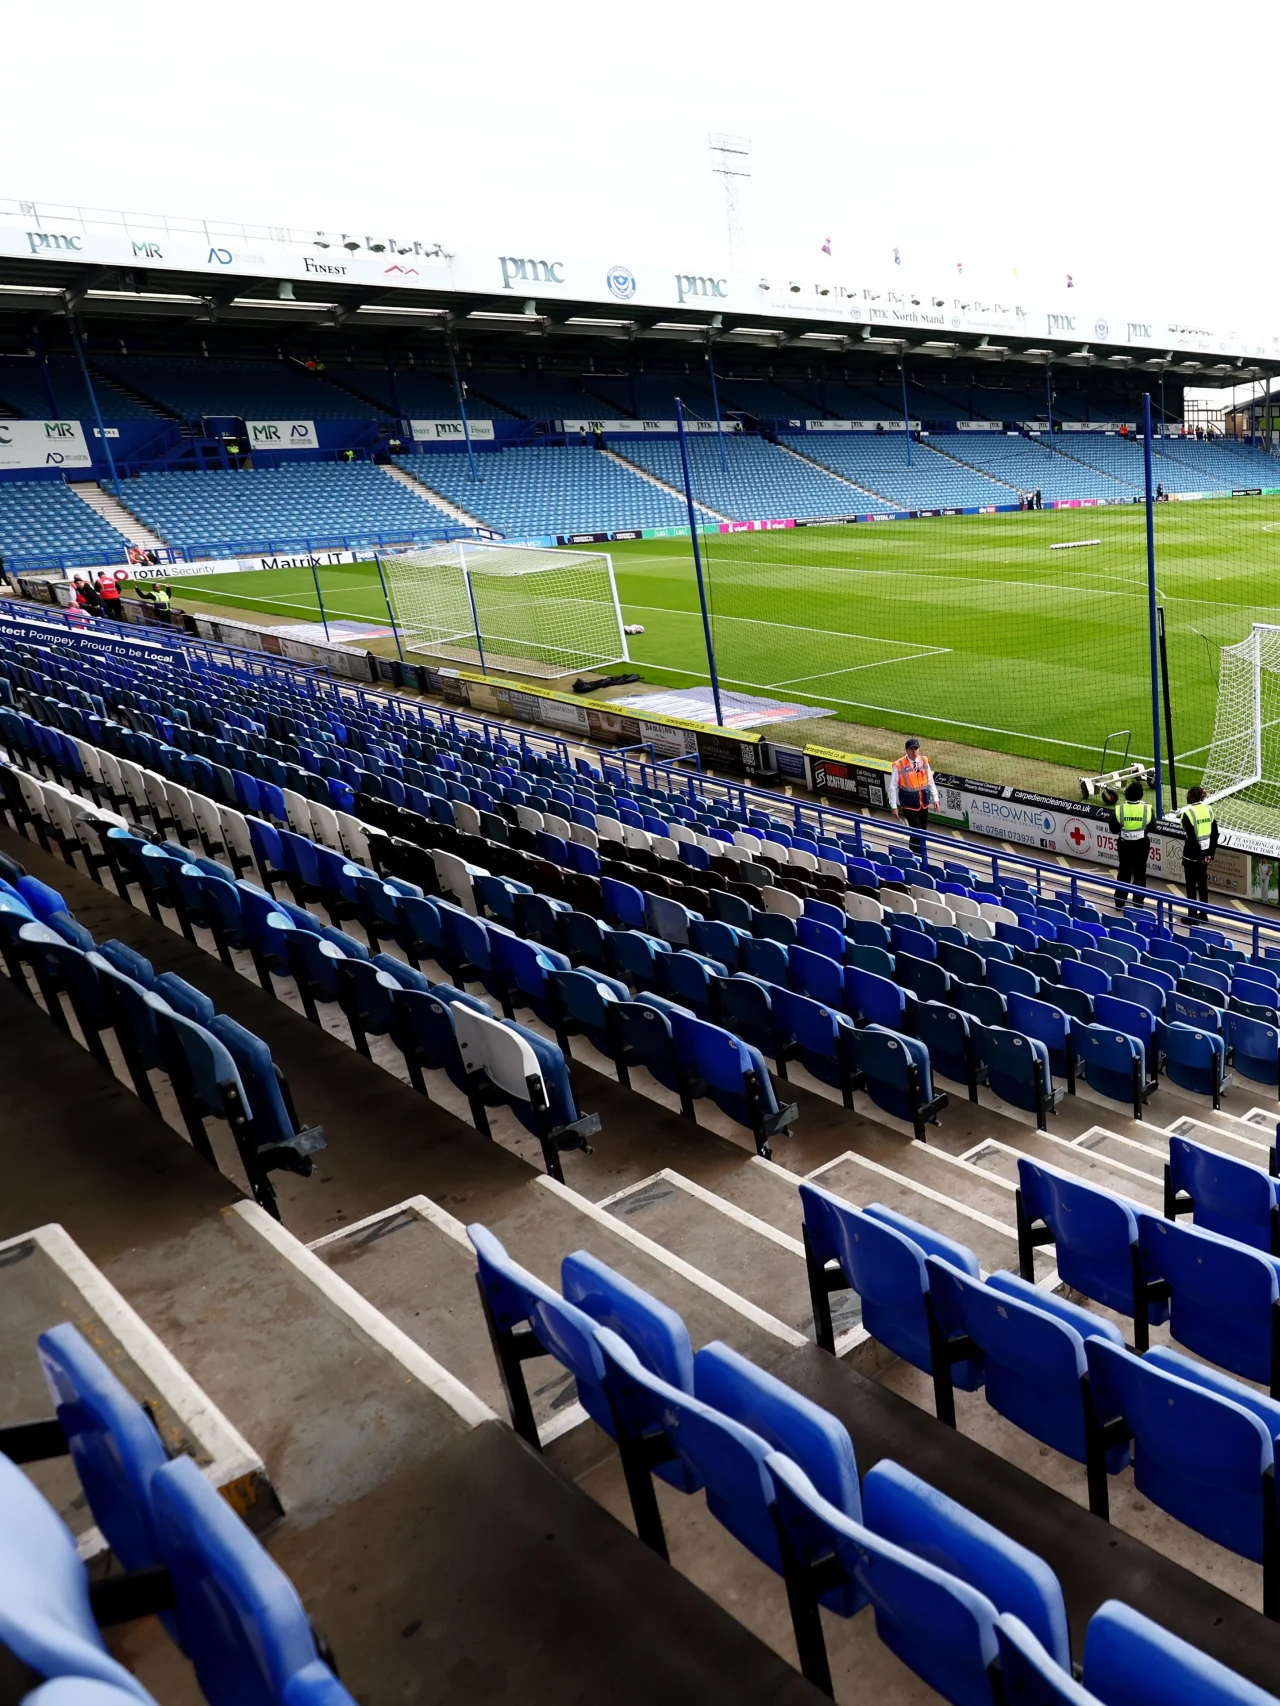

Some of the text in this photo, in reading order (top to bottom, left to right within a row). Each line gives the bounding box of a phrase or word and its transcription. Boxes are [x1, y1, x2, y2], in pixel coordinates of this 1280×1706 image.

[26, 231, 84, 254] pmc
[131, 241, 163, 258] MR
[498, 256, 566, 289] pmc
[675, 274, 729, 303] pmc
[893, 310, 918, 322] North
[920, 313, 944, 324] Stand
[1047, 313, 1076, 335] pmc
[1126, 322, 1152, 342] pmc
[44, 422, 76, 437] MR
[253, 424, 281, 439] MR
[434, 423, 462, 437] pmc
[261, 555, 322, 570] Matrix
[326, 552, 343, 565] IT
[133, 562, 215, 580] TOTAL Security
[29, 630, 175, 664] Pompey. Proud to be Local.
[983, 782, 998, 790] Cleaning
[1014, 790, 1092, 813] carpediemcleaning.co.uk
[970, 799, 1043, 827] A.BROWNE
[972, 822, 1035, 845] Tel: 07581 073976
[1232, 842, 1275, 856] CONTRACTORS
[1234, 836, 1270, 850] PLASTERING
